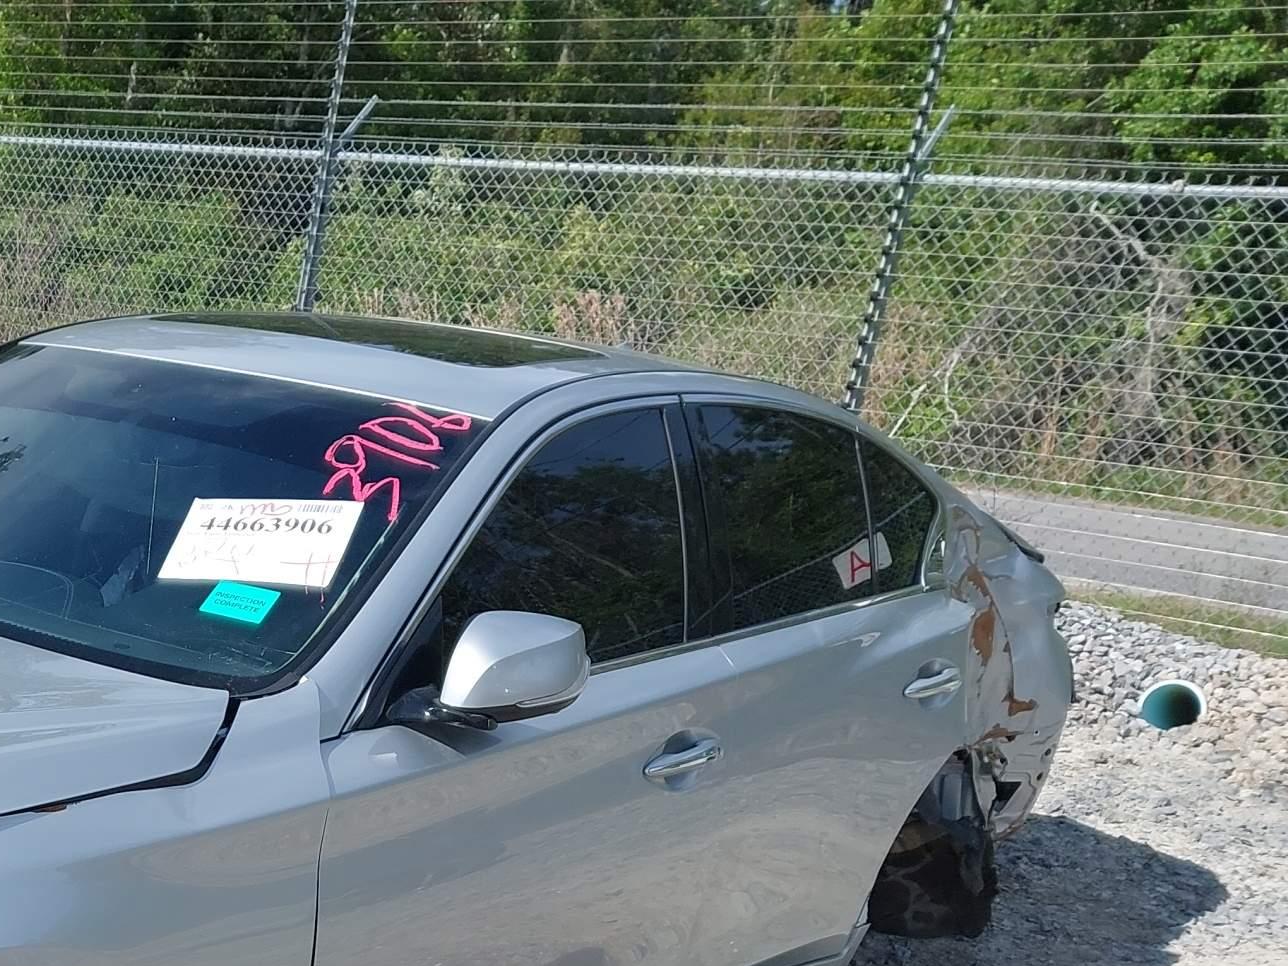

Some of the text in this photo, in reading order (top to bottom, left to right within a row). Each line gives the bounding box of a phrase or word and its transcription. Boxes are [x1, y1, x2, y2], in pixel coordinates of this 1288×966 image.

[199, 515, 335, 536] 44663906
[213, 598, 262, 613] COMPLETE
[215, 591, 267, 607] INSPECTION
